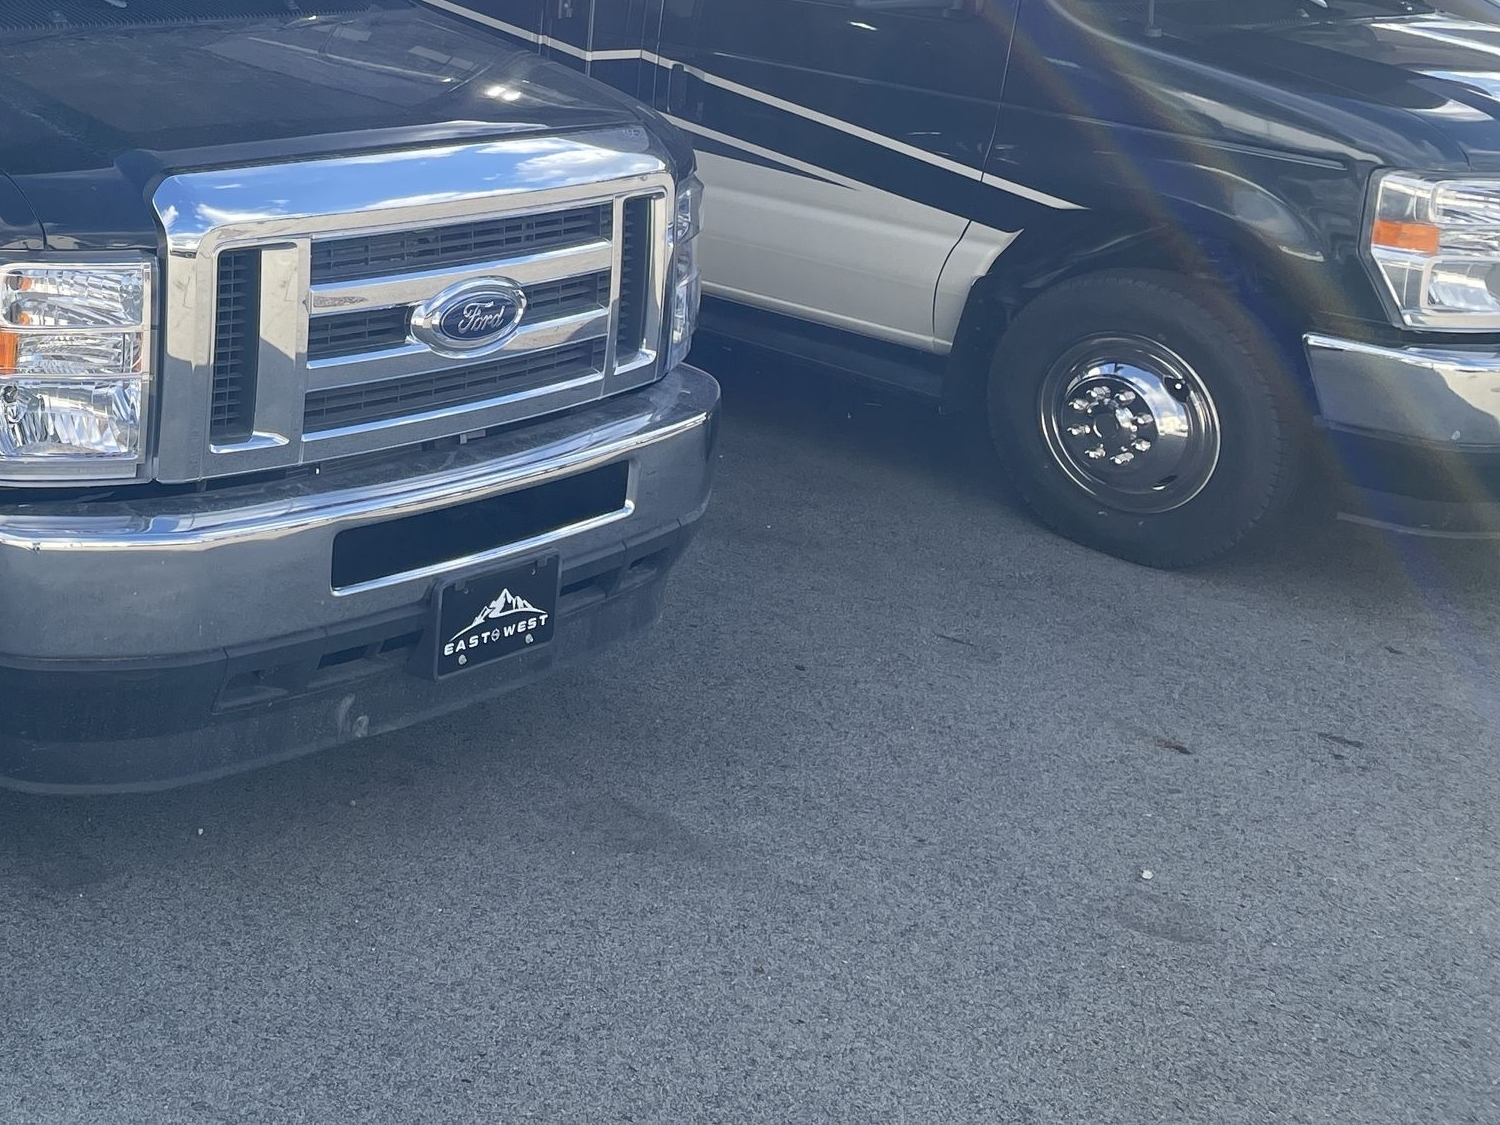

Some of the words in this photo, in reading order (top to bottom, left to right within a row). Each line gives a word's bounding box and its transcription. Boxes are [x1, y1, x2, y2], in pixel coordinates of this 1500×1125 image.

[457, 301, 506, 334] Ford
[443, 631, 491, 656] EAST
[503, 614, 549, 637] WEST
